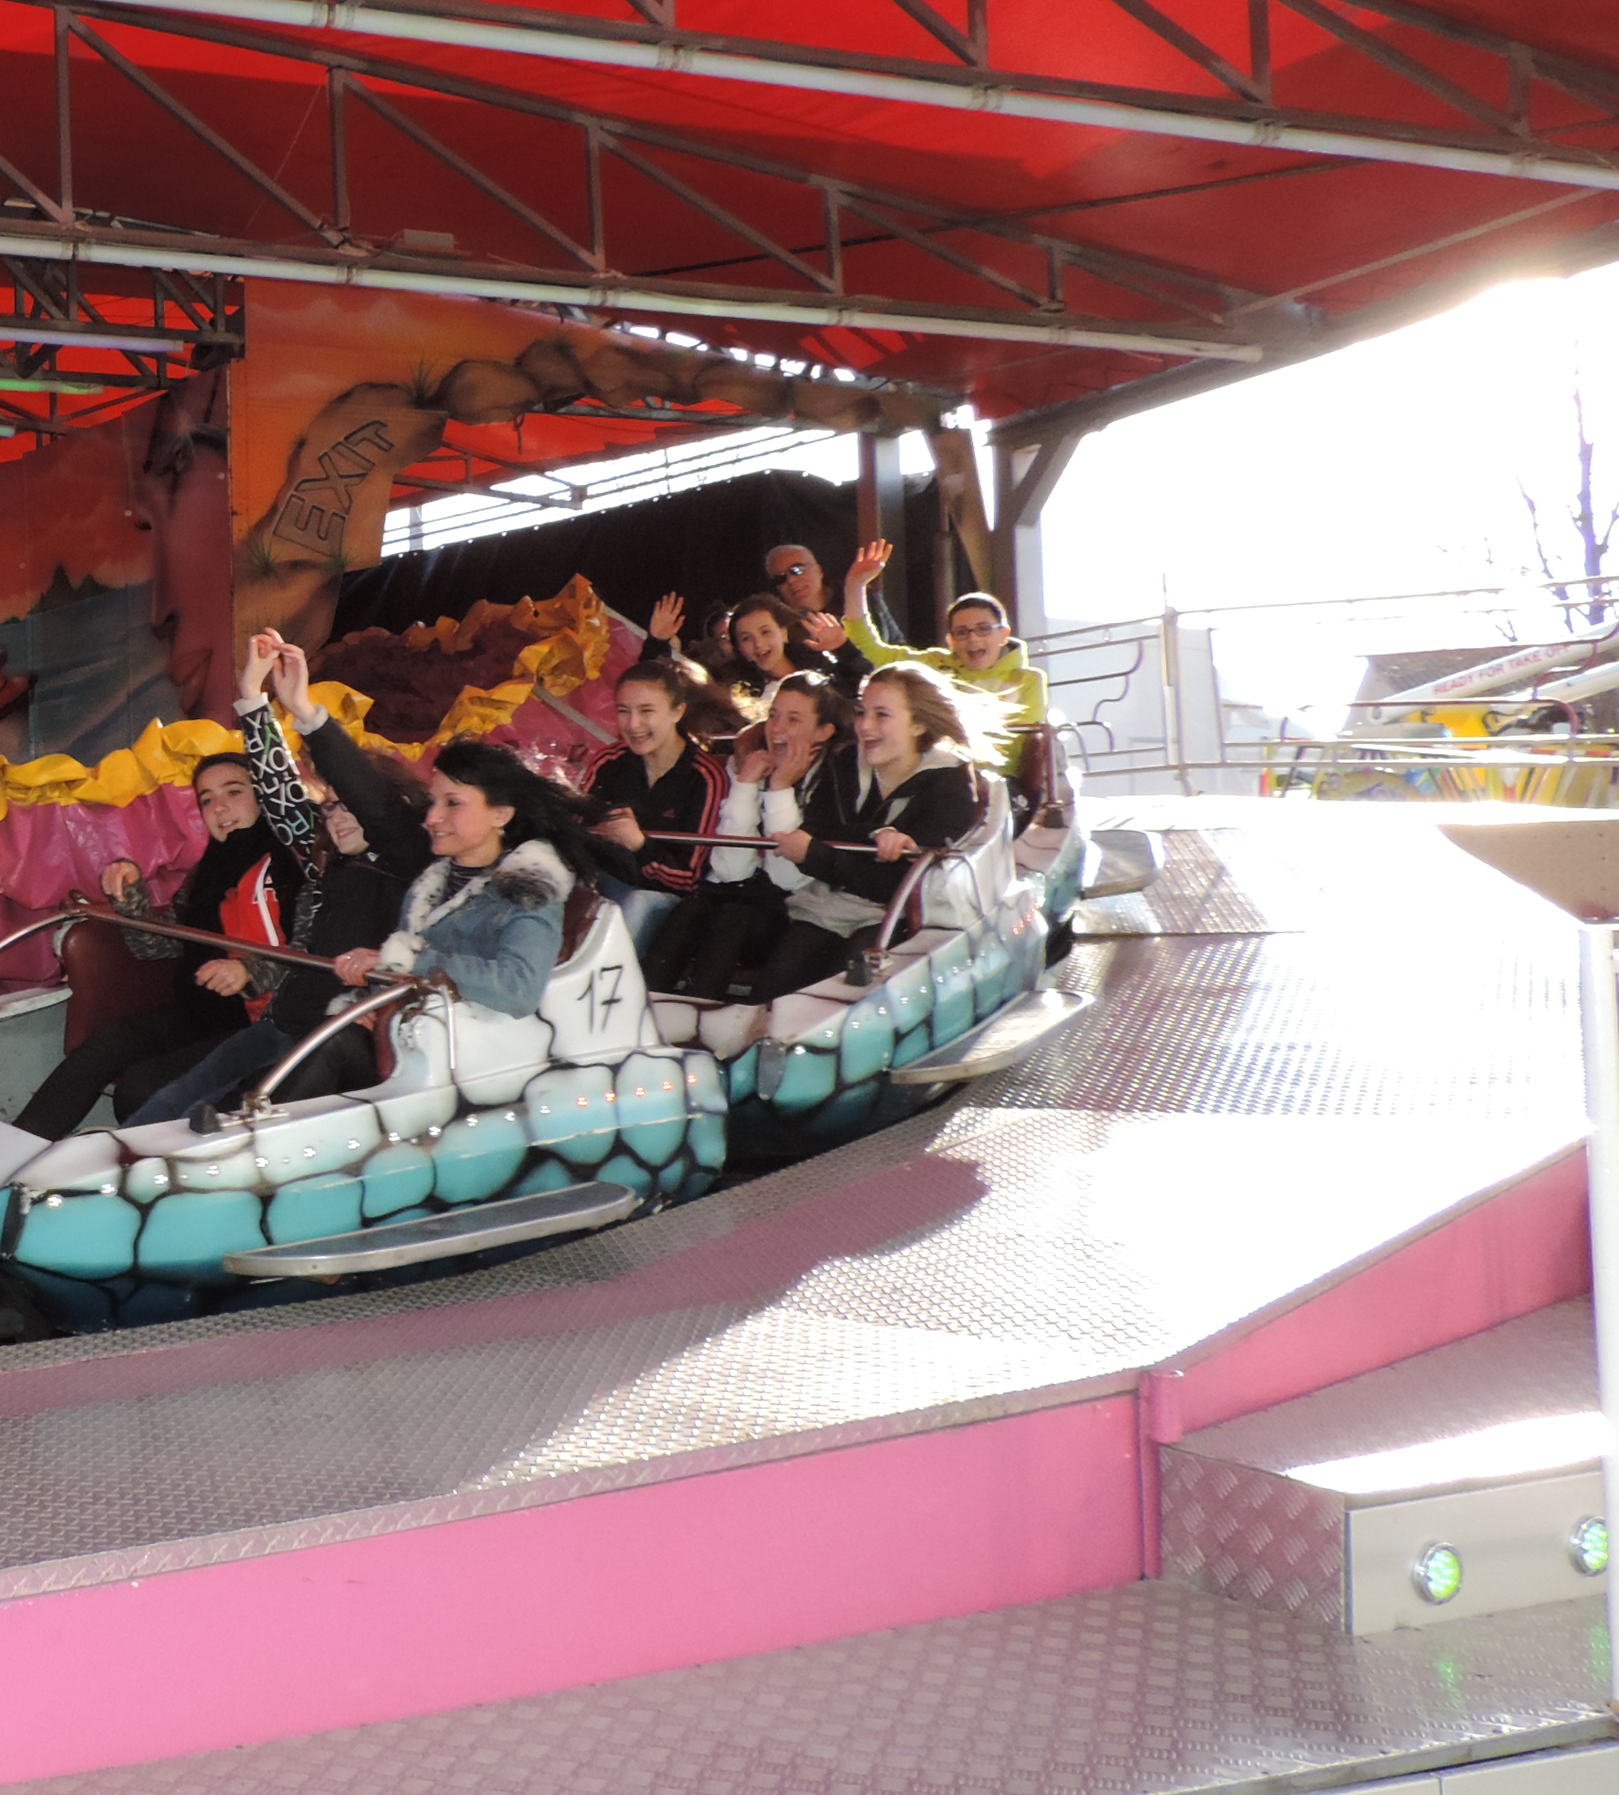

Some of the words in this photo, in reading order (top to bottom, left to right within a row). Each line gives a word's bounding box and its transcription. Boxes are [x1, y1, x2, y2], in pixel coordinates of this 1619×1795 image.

[272, 419, 396, 558] EXIT
[1432, 675, 1473, 694] READY
[1479, 663, 1504, 680] FOR
[1510, 650, 1542, 669] TAKE
[576, 964, 623, 1035] 17
